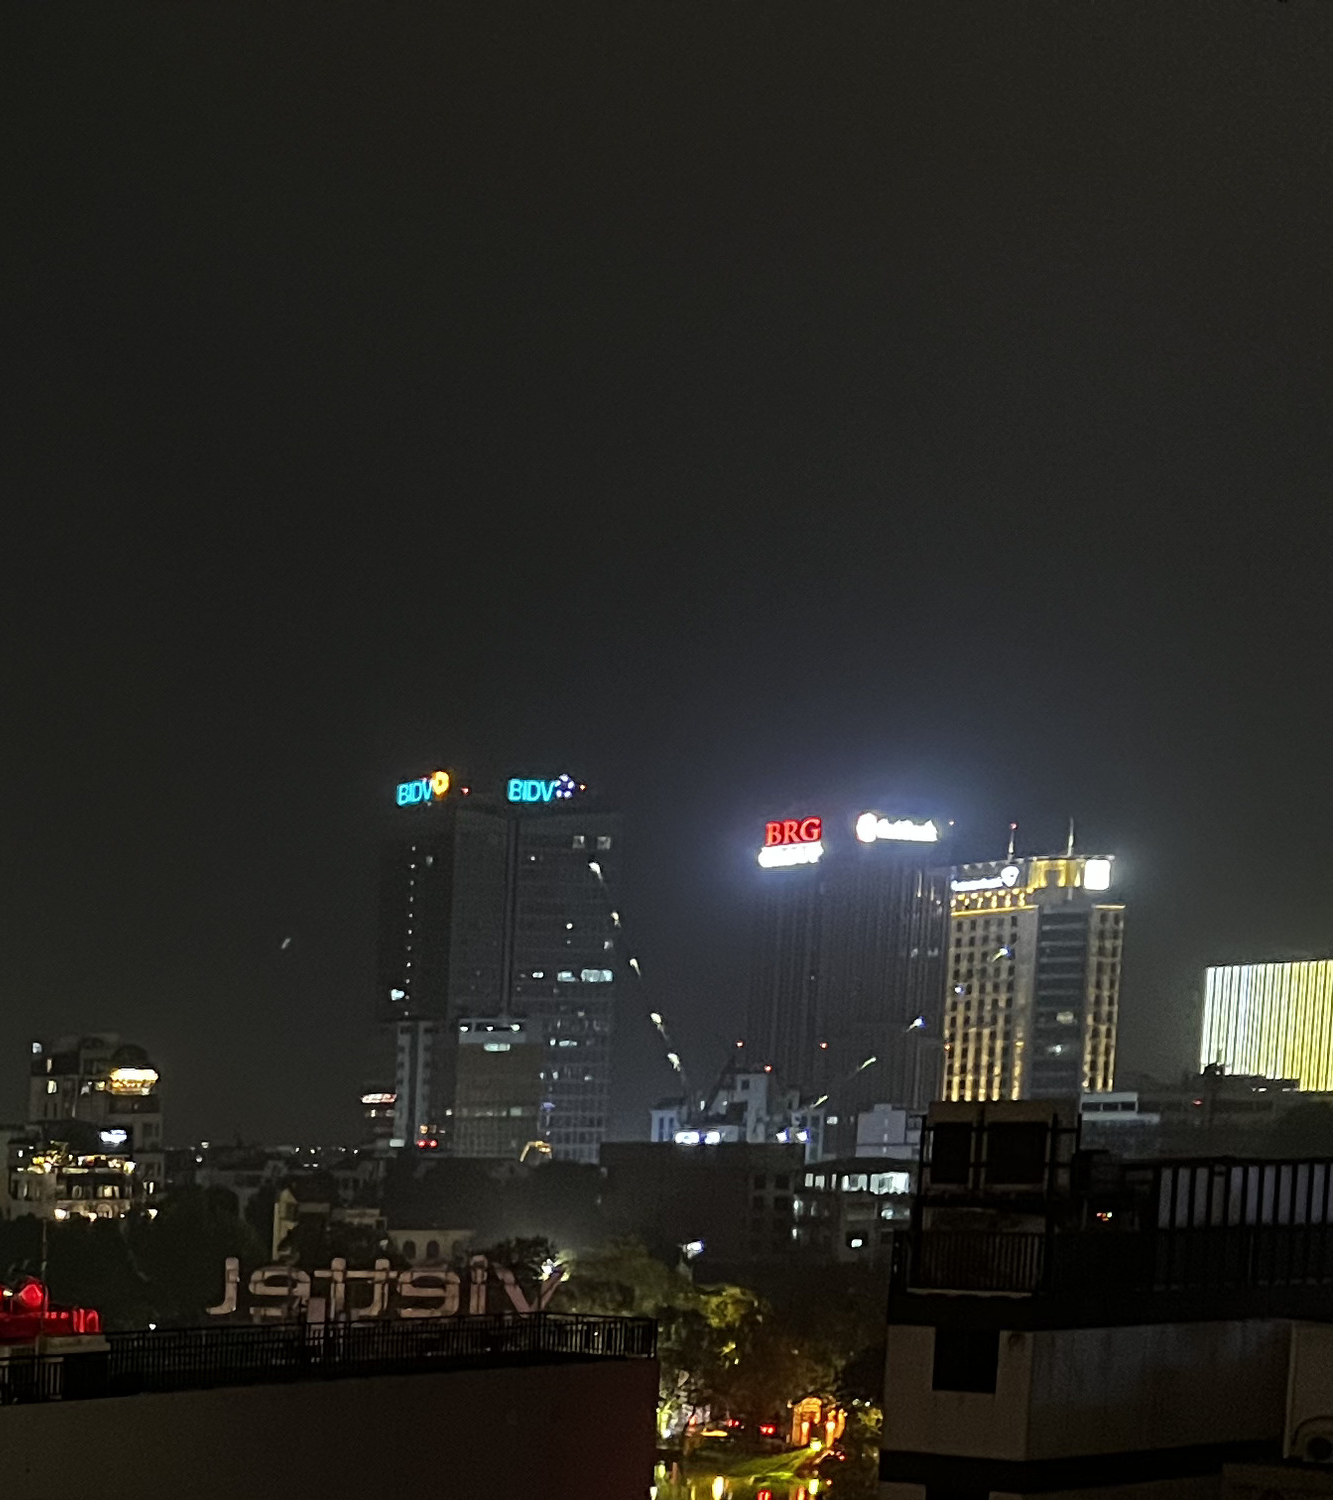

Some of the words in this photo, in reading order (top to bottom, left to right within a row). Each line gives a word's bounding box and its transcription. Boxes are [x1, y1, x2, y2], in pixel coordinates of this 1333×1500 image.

[396, 780, 433, 806] BIDV
[508, 779, 555, 801] BIDV
[766, 818, 821, 846] BRG
